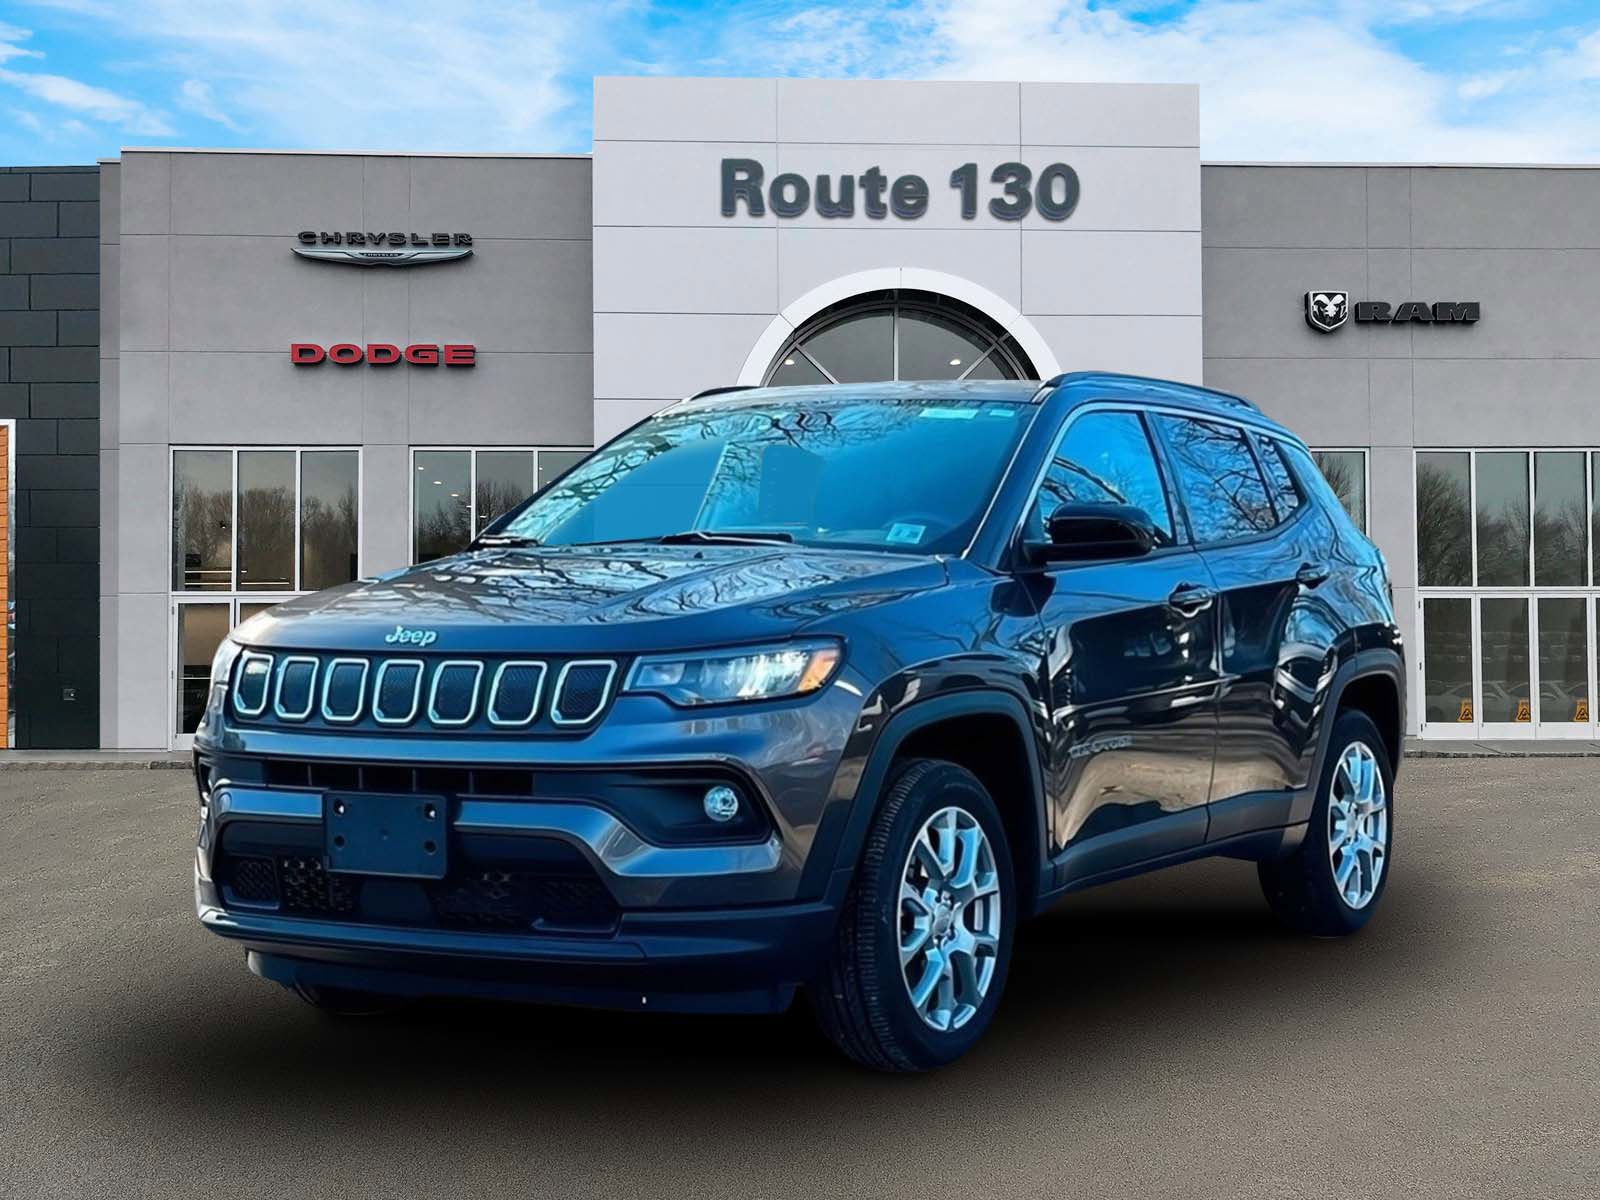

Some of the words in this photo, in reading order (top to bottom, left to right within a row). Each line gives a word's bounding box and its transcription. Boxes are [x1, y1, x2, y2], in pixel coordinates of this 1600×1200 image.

[721, 158, 929, 219] Route
[950, 161, 1081, 222] 130
[298, 231, 473, 245] CHRYSLER
[1354, 302, 1481, 324] RAM
[291, 343, 476, 367] DODGE
[385, 625, 437, 647] Jeep
